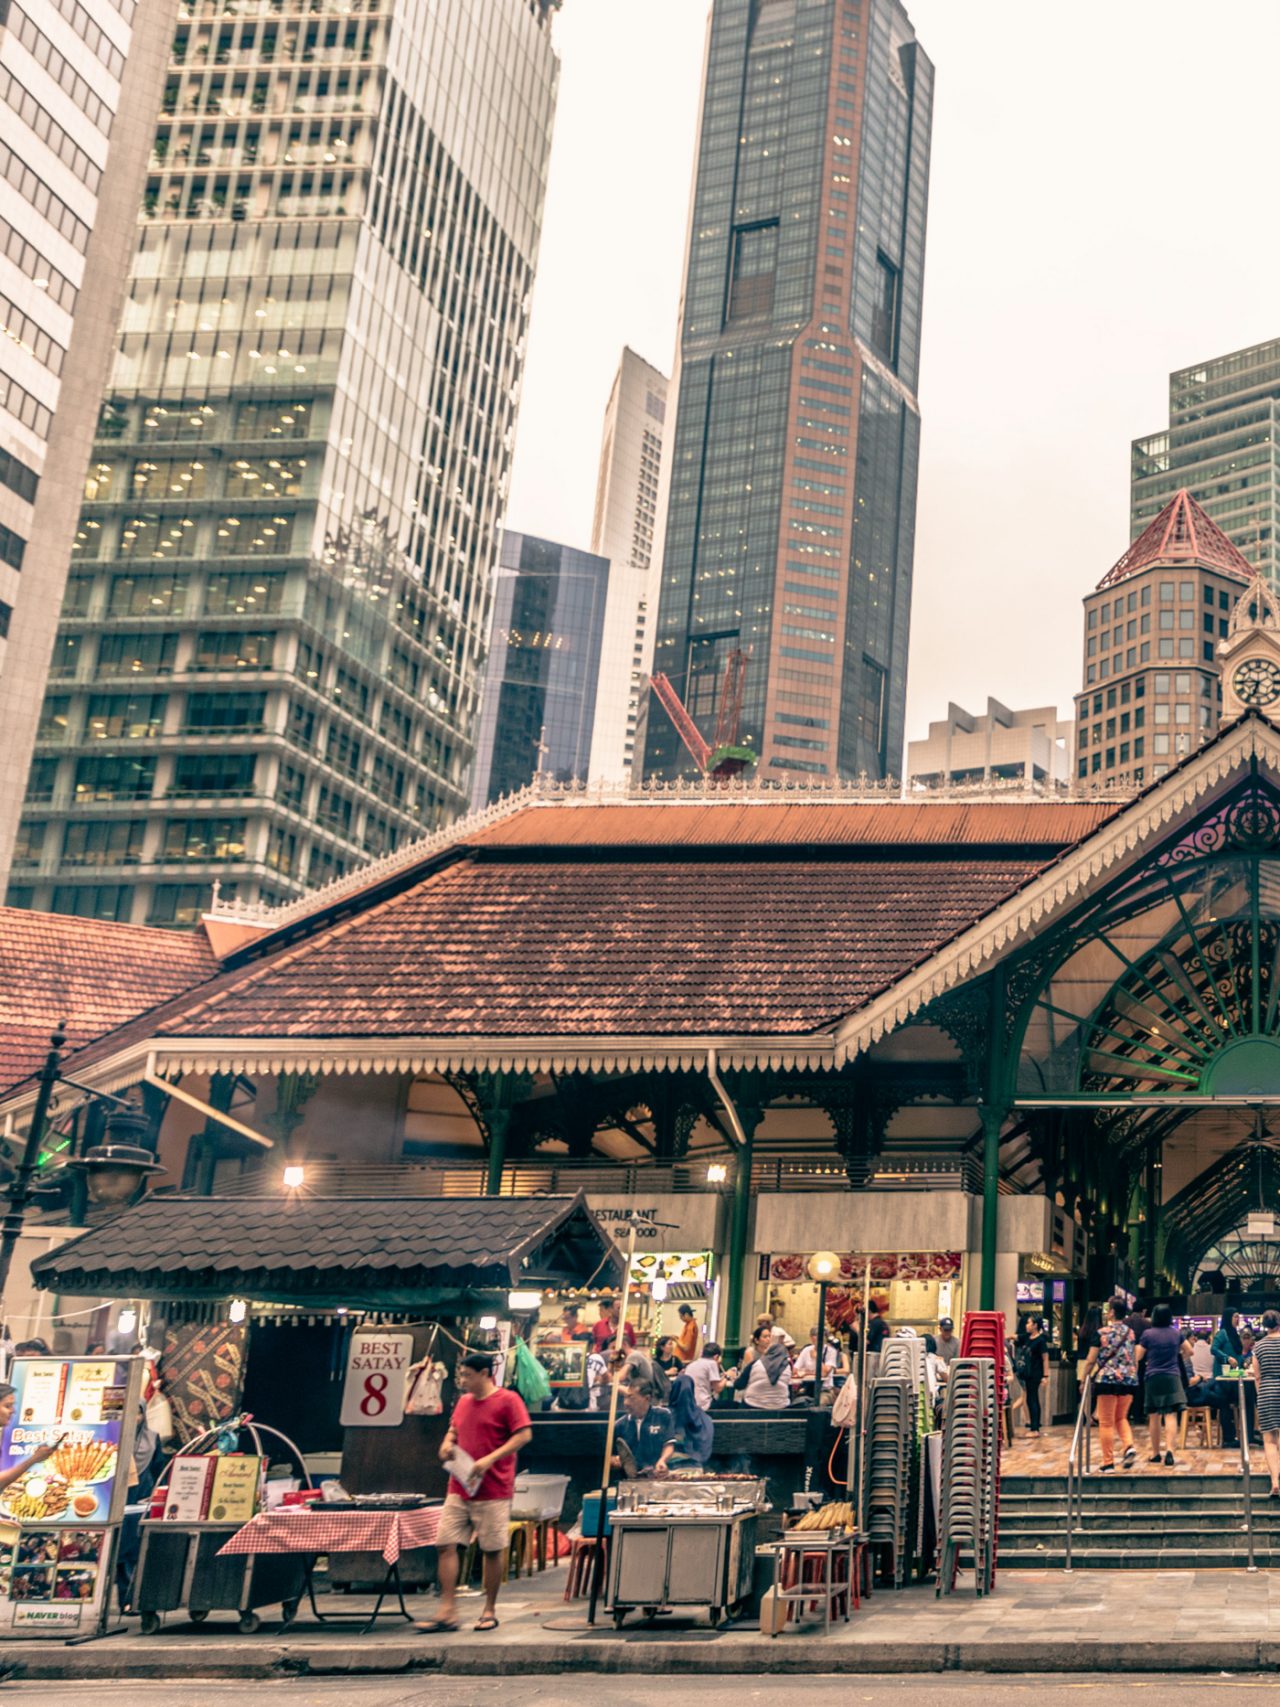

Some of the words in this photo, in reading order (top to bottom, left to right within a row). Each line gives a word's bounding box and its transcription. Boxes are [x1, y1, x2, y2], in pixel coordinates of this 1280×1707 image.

[589, 1209, 658, 1221] ESTAURANT
[614, 1228, 657, 1238] SEAOOD
[361, 1342, 402, 1355] BEST
[351, 1357, 406, 1370] SATAY
[360, 1373, 388, 1417] 8
[12, 1428, 48, 1442] Best
